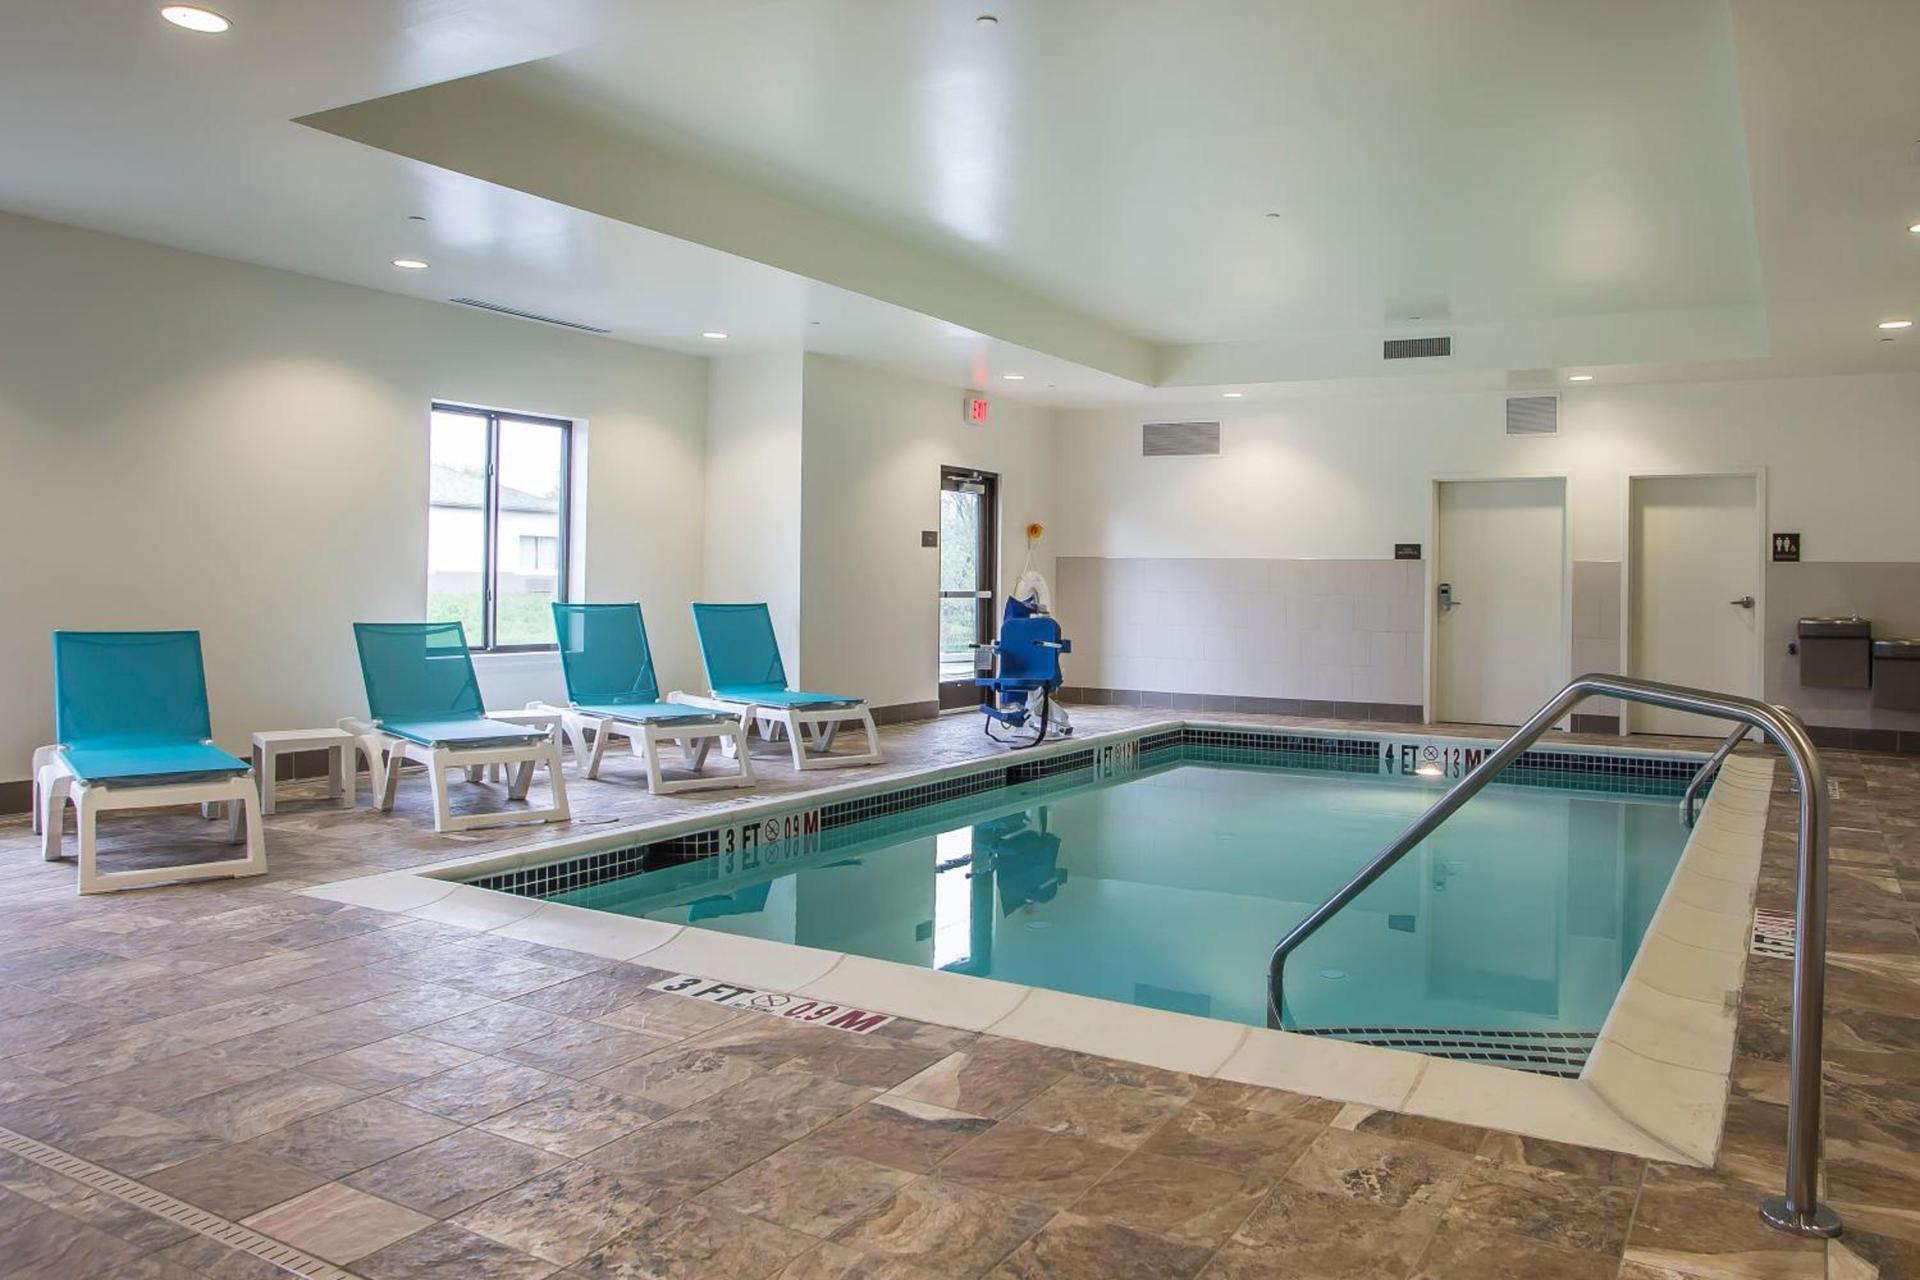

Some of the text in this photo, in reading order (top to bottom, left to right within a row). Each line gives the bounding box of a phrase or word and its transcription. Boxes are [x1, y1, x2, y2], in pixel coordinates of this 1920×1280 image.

[973, 399, 988, 420] EXIT
[1385, 743, 1394, 759] 4
[1401, 745, 1419, 761] FT
[1465, 749, 1482, 767] M
[725, 828, 735, 853] 3
[742, 822, 761, 848] FT
[804, 810, 819, 835] M
[663, 979, 702, 991] 3
[691, 984, 756, 1001] FT
[783, 1002, 839, 1021] 0.9
[826, 1010, 889, 1031] M
